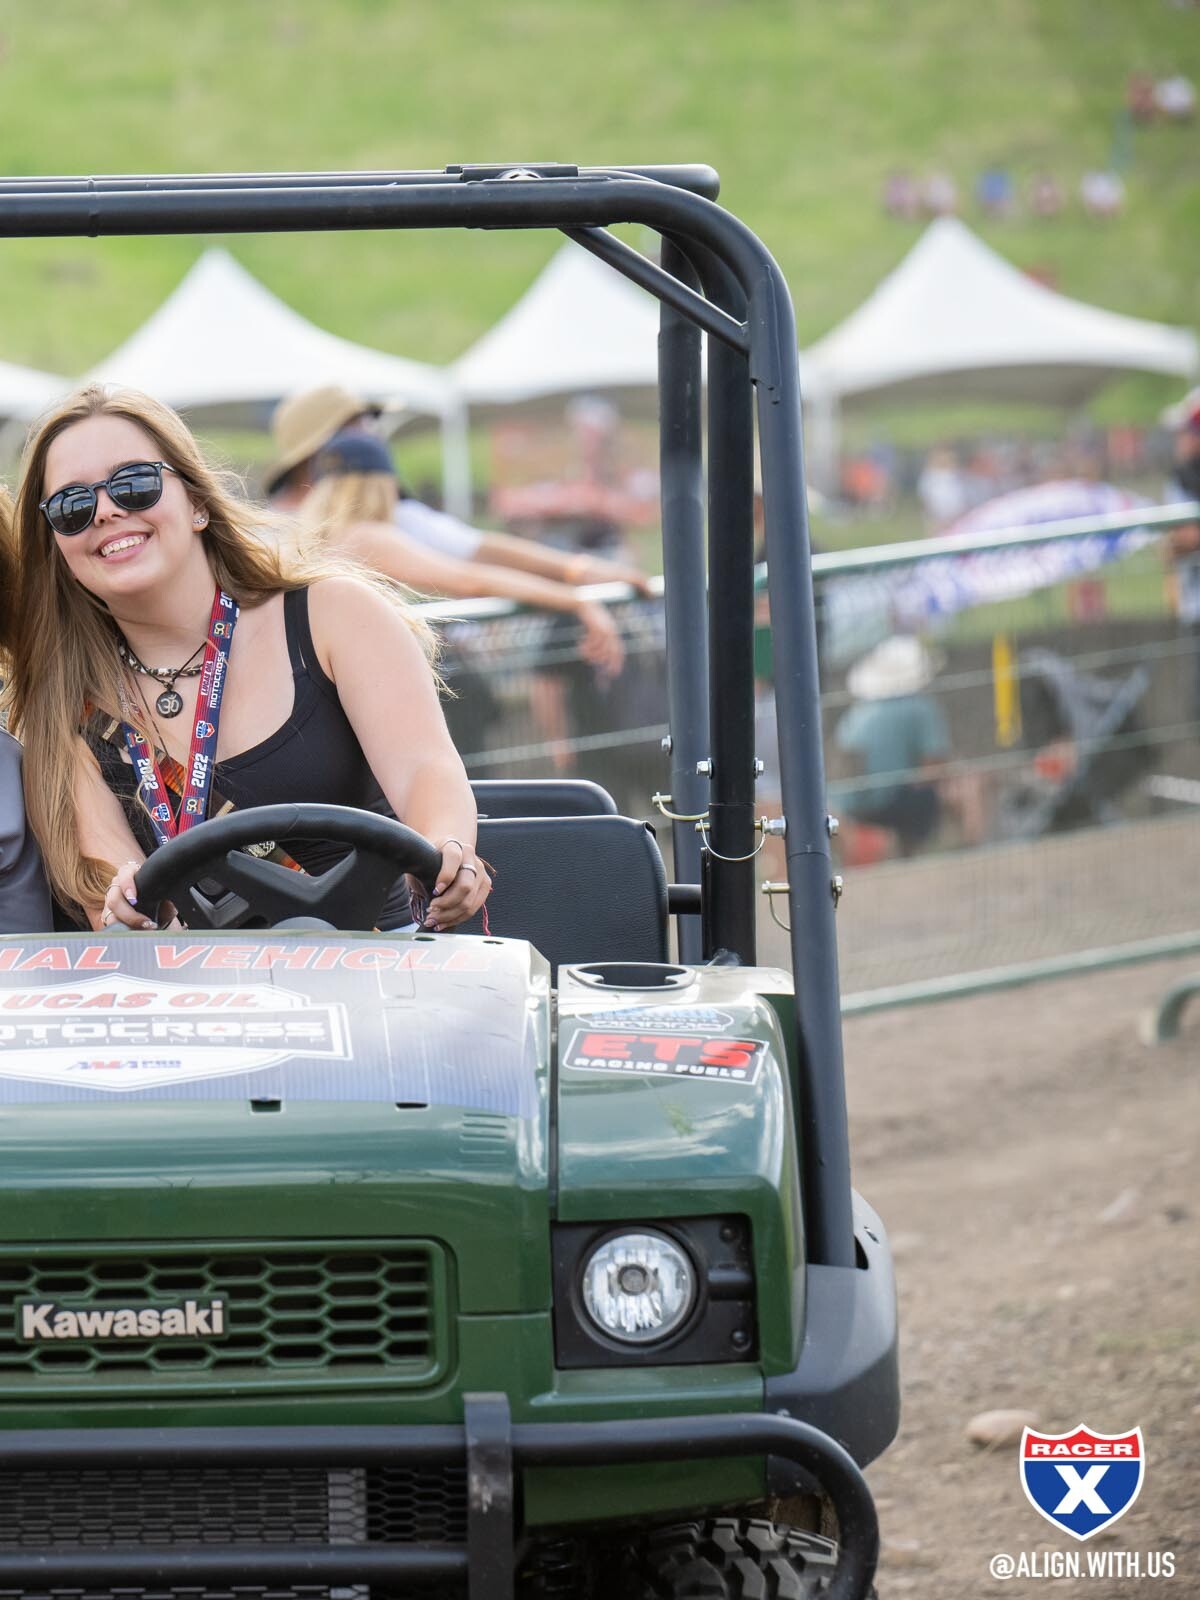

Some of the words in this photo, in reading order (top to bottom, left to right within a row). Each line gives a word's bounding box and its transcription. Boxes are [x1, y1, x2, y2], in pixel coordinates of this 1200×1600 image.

[209, 651, 225, 709] MOTOCROSS
[137, 758, 159, 791] 2022
[191, 753, 209, 788] 2022
[186, 798, 197, 812] 50
[154, 944, 493, 973] VEHICLE
[168, 992, 259, 1009] OIL
[581, 1033, 757, 1068] ETS
[574, 1057, 668, 1072] RACING
[675, 1064, 747, 1079] FUELS
[22, 1300, 224, 1339] Kawasaki
